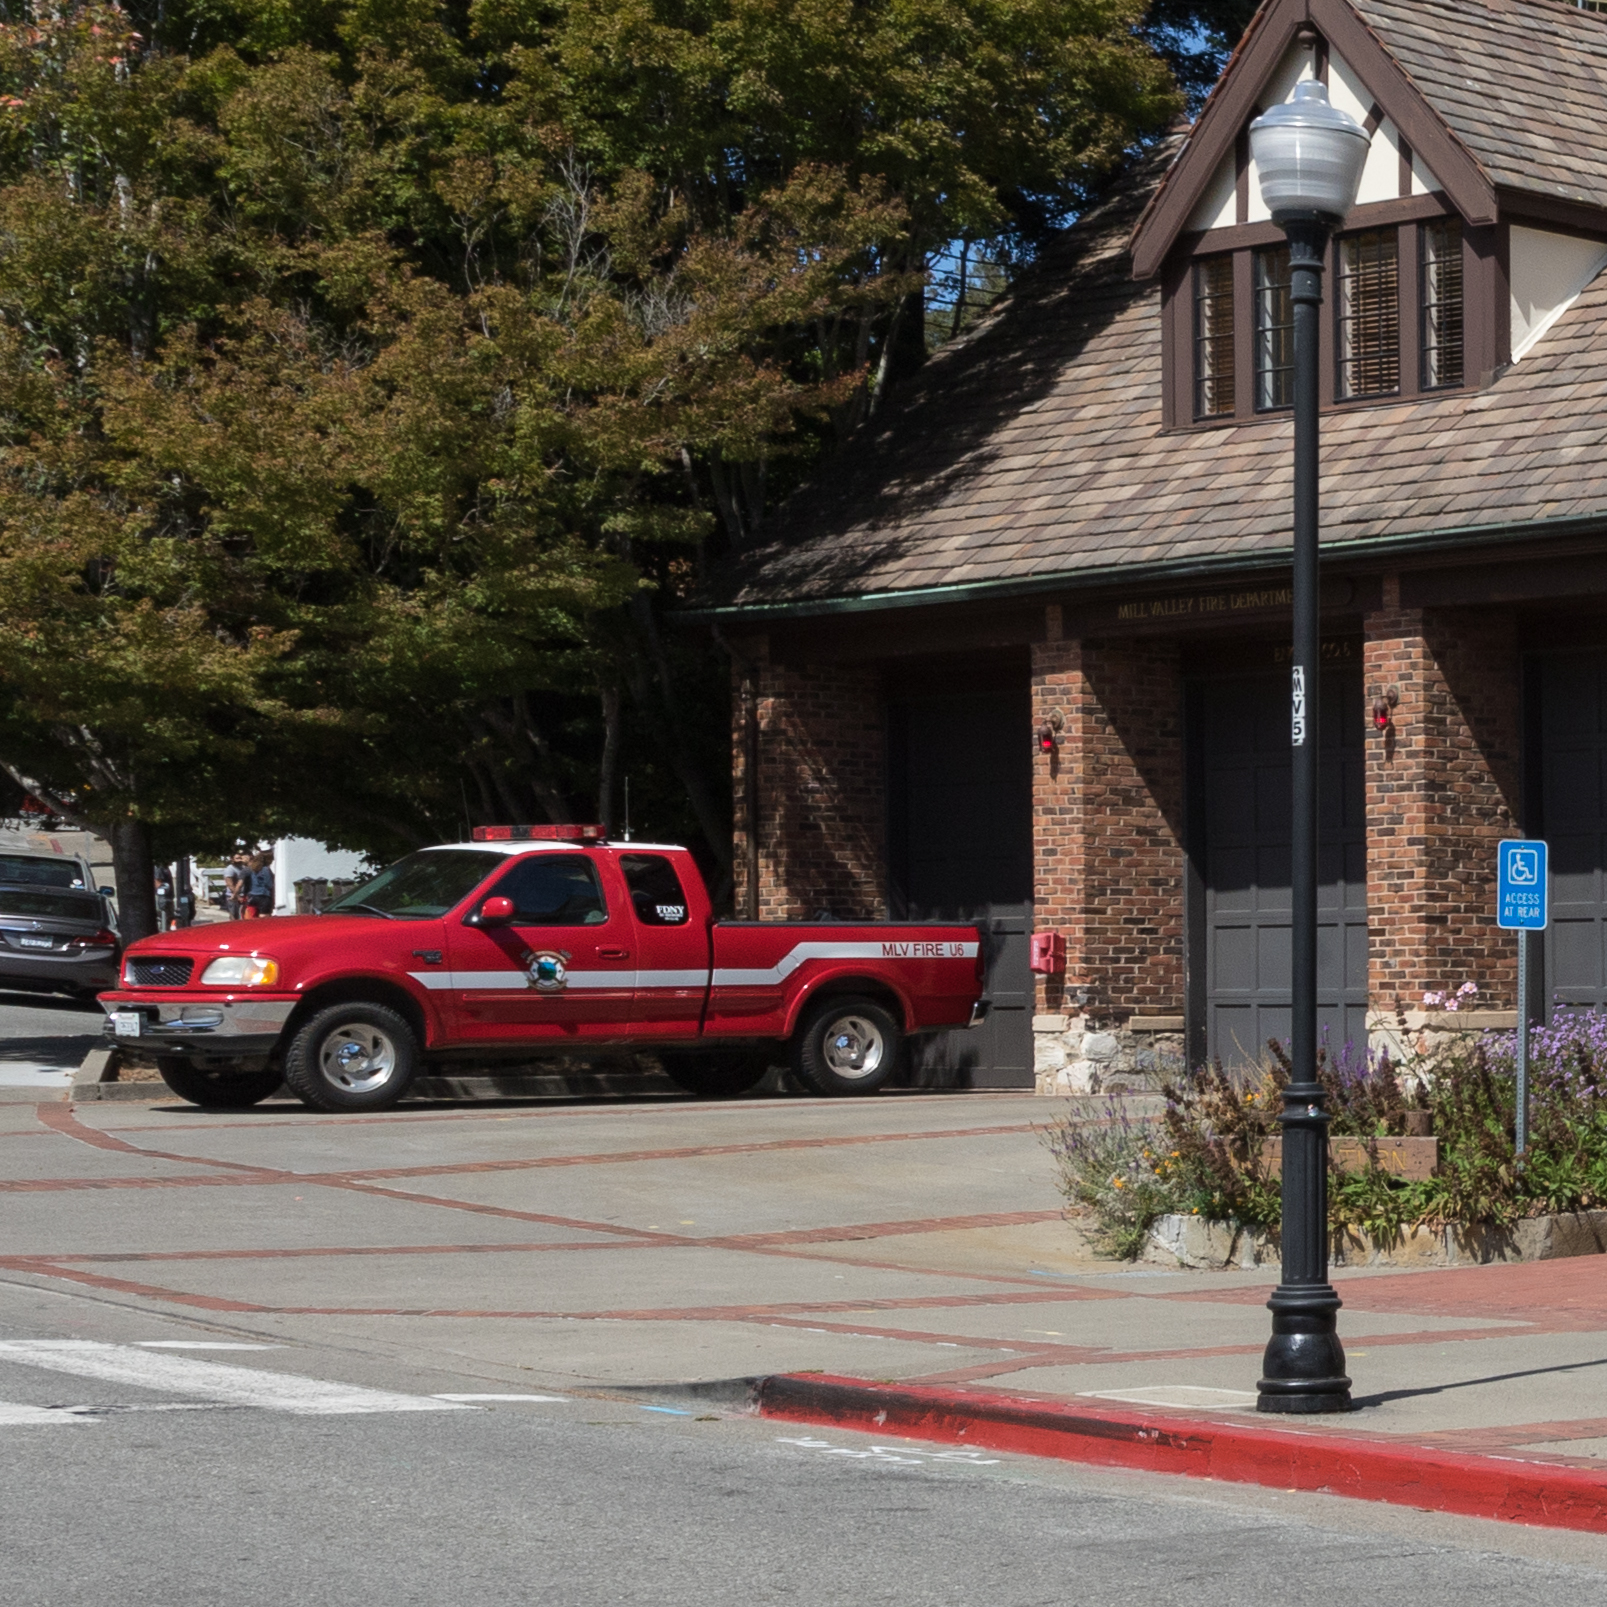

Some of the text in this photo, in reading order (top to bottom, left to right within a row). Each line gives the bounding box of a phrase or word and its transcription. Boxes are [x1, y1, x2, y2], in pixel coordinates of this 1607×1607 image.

[1118, 589, 1293, 619] MILL VALLEY FIRE DEPARTME
[1505, 893, 1540, 905] ACCESS
[656, 905, 684, 914] FDNY
[1504, 907, 1540, 918] AT REAR
[882, 943, 964, 956] MLV FIRE U6
